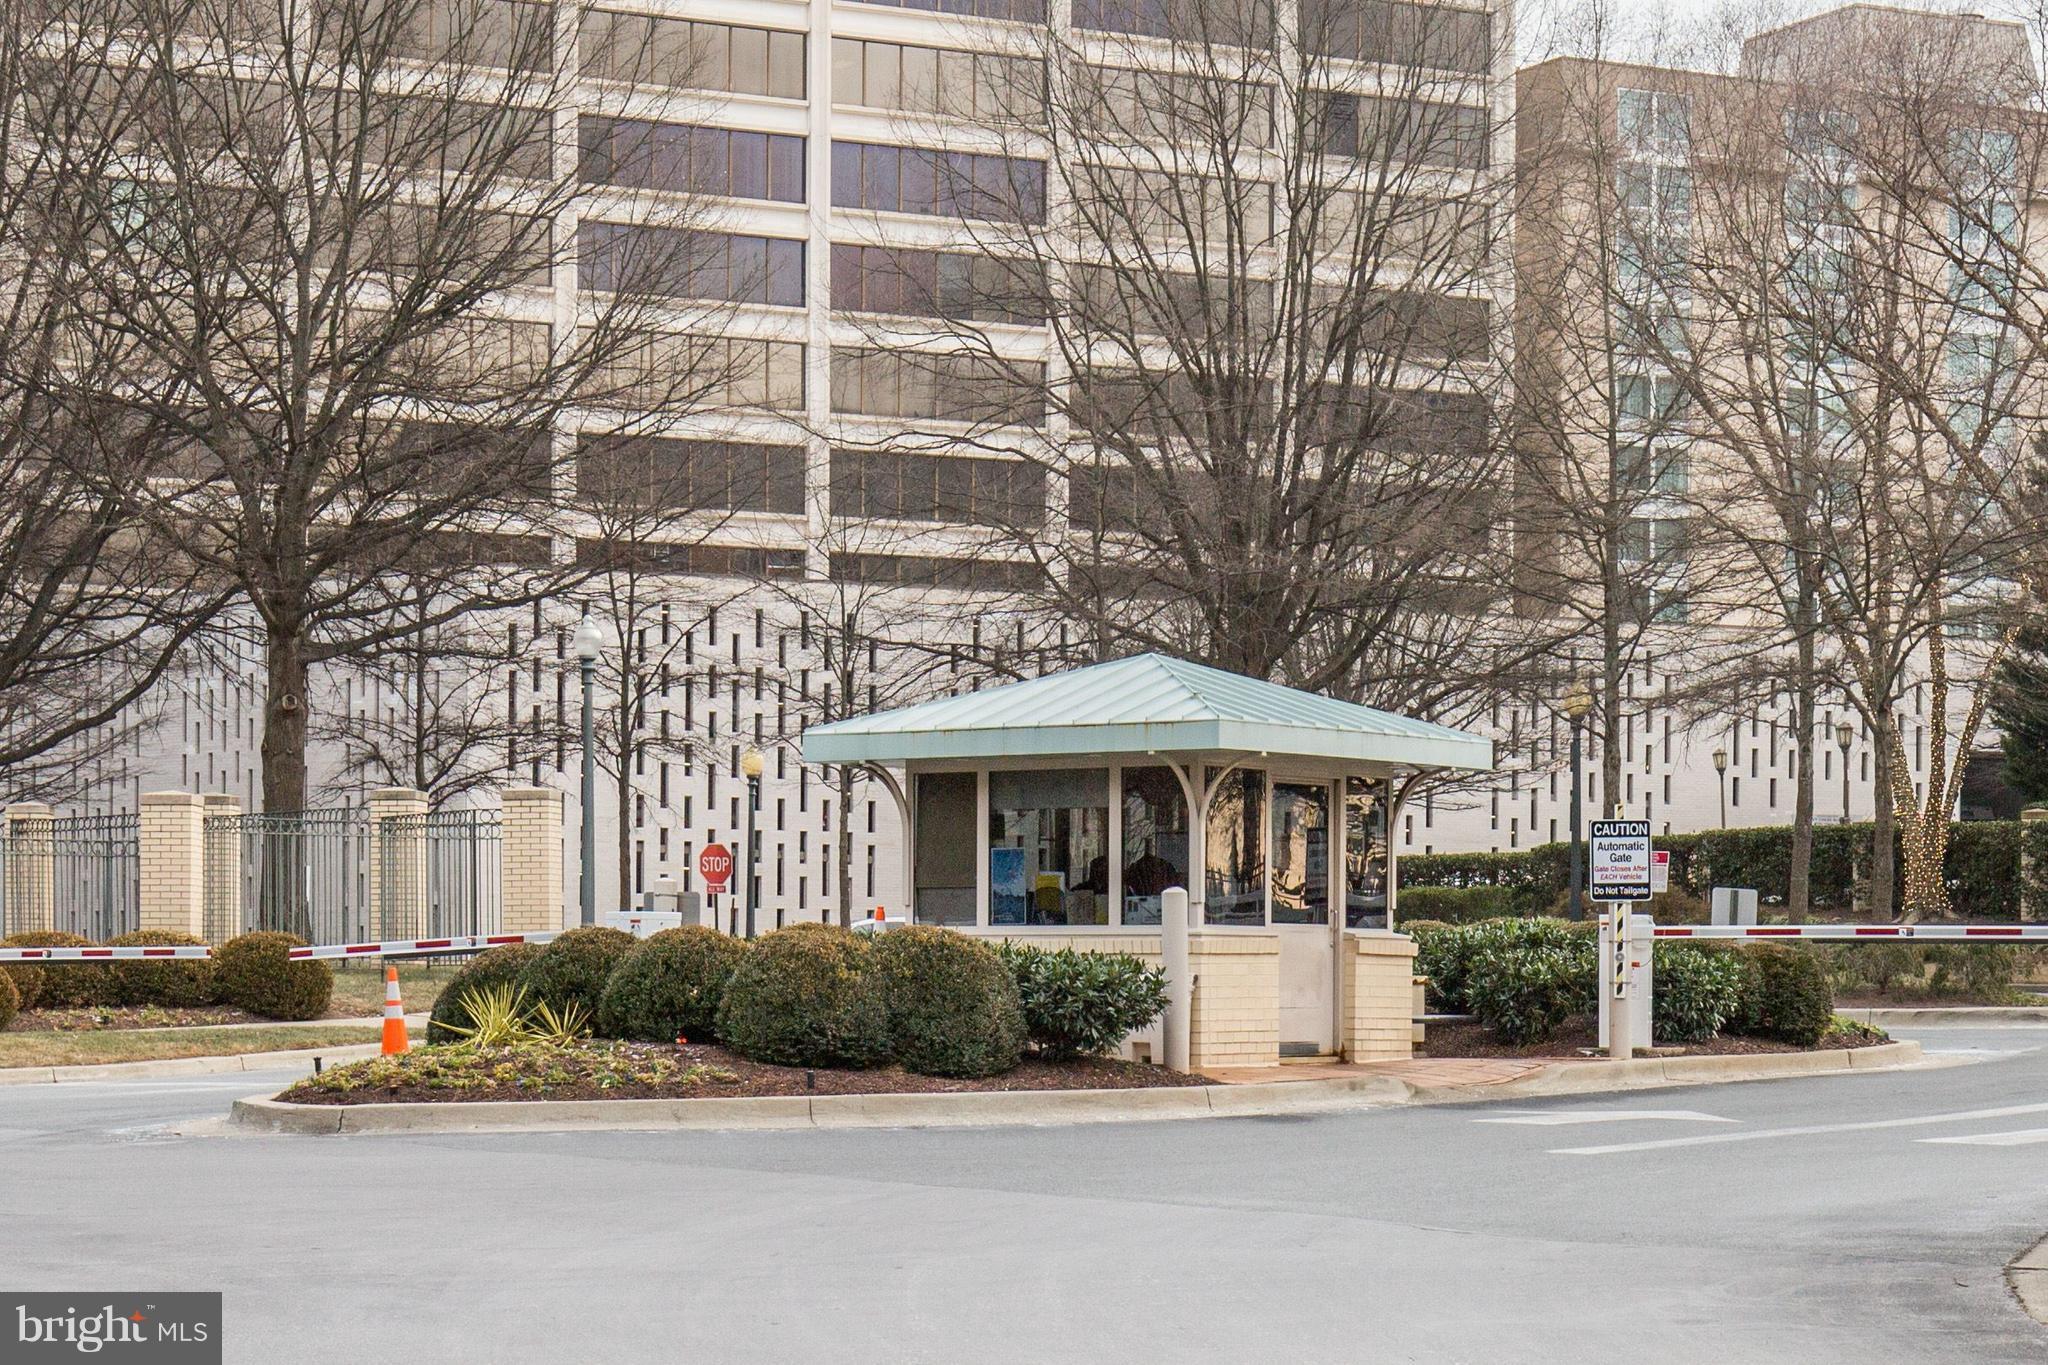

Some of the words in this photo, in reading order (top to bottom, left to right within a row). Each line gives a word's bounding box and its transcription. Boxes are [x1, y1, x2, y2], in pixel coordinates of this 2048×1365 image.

[1594, 823, 1647, 835] CAUTION
[1597, 841, 1645, 851] Automatic
[1609, 853, 1632, 862] Gate
[702, 856, 730, 872] STOP
[1594, 887, 1604, 895] Do
[1605, 887, 1618, 895] Not
[1619, 886, 1648, 896] Tailgate
